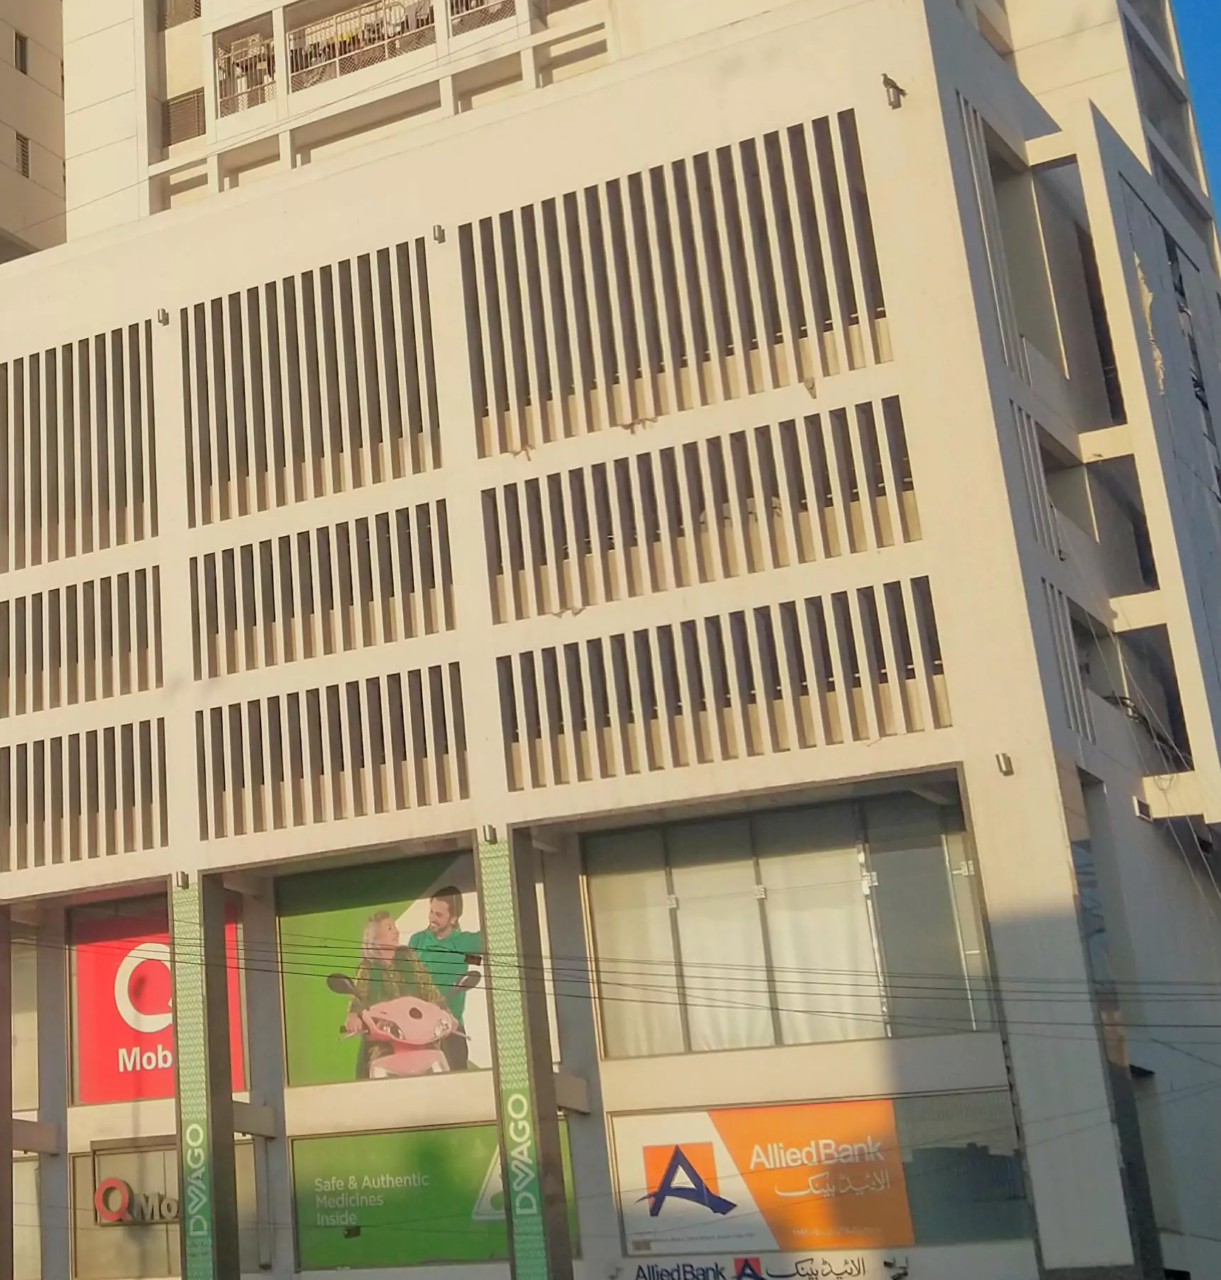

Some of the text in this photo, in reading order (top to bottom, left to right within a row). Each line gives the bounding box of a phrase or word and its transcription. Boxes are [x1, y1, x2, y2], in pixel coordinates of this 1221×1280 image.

[118, 1044, 173, 1072] Mob
[507, 1093, 538, 1215] DVAGO
[315, 1172, 430, 1192] Safe & Authentic
[316, 1193, 384, 1209] Medicines
[317, 1210, 357, 1226] Inside
